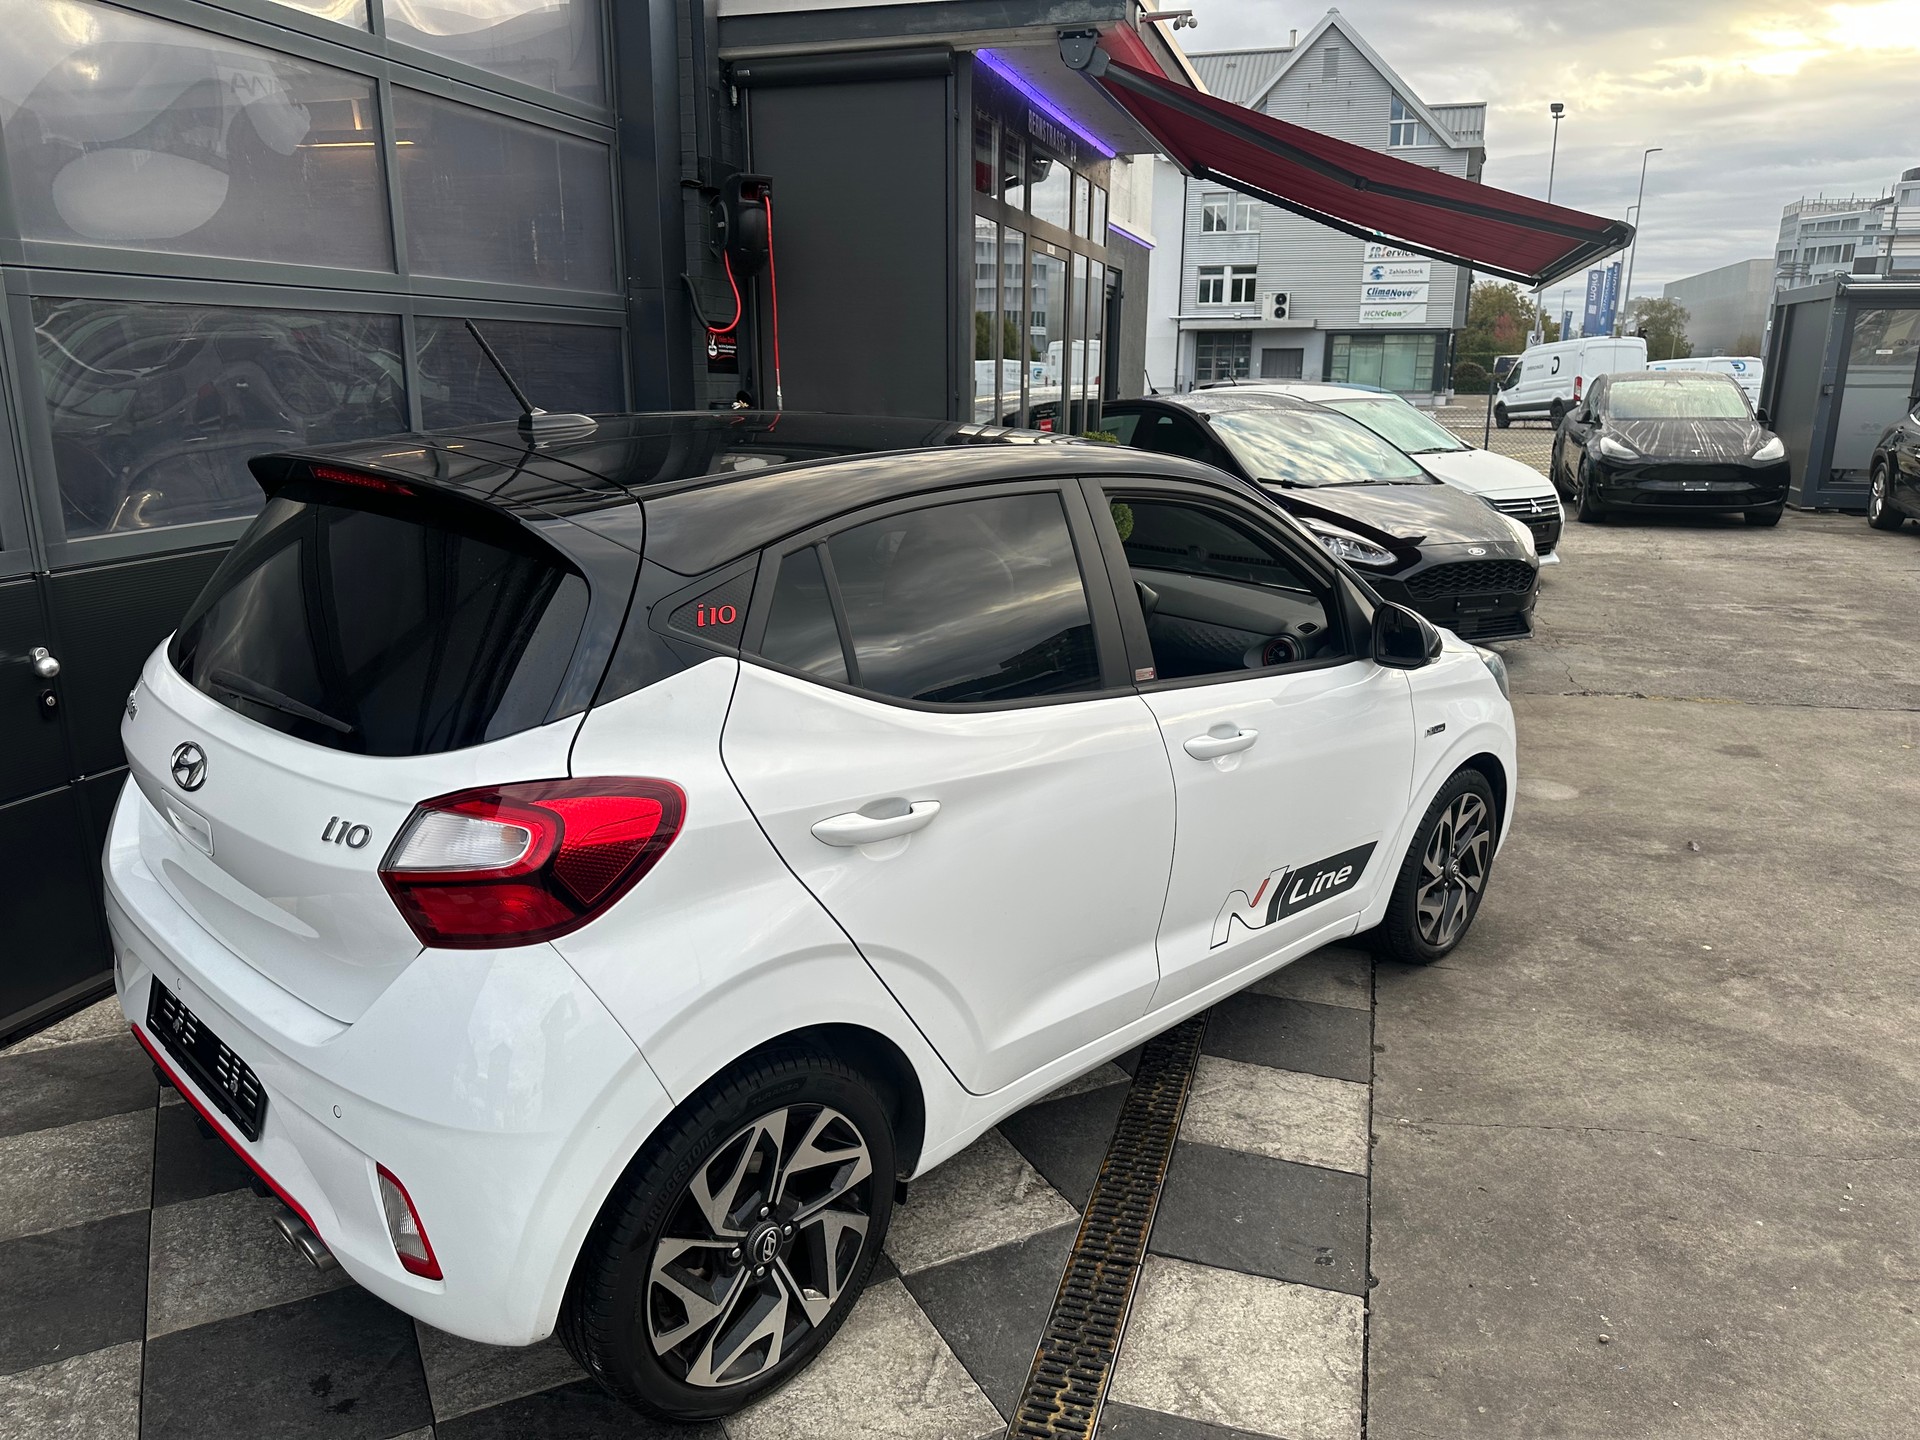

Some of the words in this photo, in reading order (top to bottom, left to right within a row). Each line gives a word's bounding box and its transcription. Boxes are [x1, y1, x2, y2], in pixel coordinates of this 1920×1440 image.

[1366, 287, 1413, 297] ClimaNova
[1363, 309, 1403, 317] HCNClean
[696, 603, 737, 627] i10
[321, 816, 373, 850] i10
[1288, 864, 1353, 905] Line
[751, 1081, 801, 1106] TURANZA
[644, 1127, 719, 1233] BRIDGESTONE
